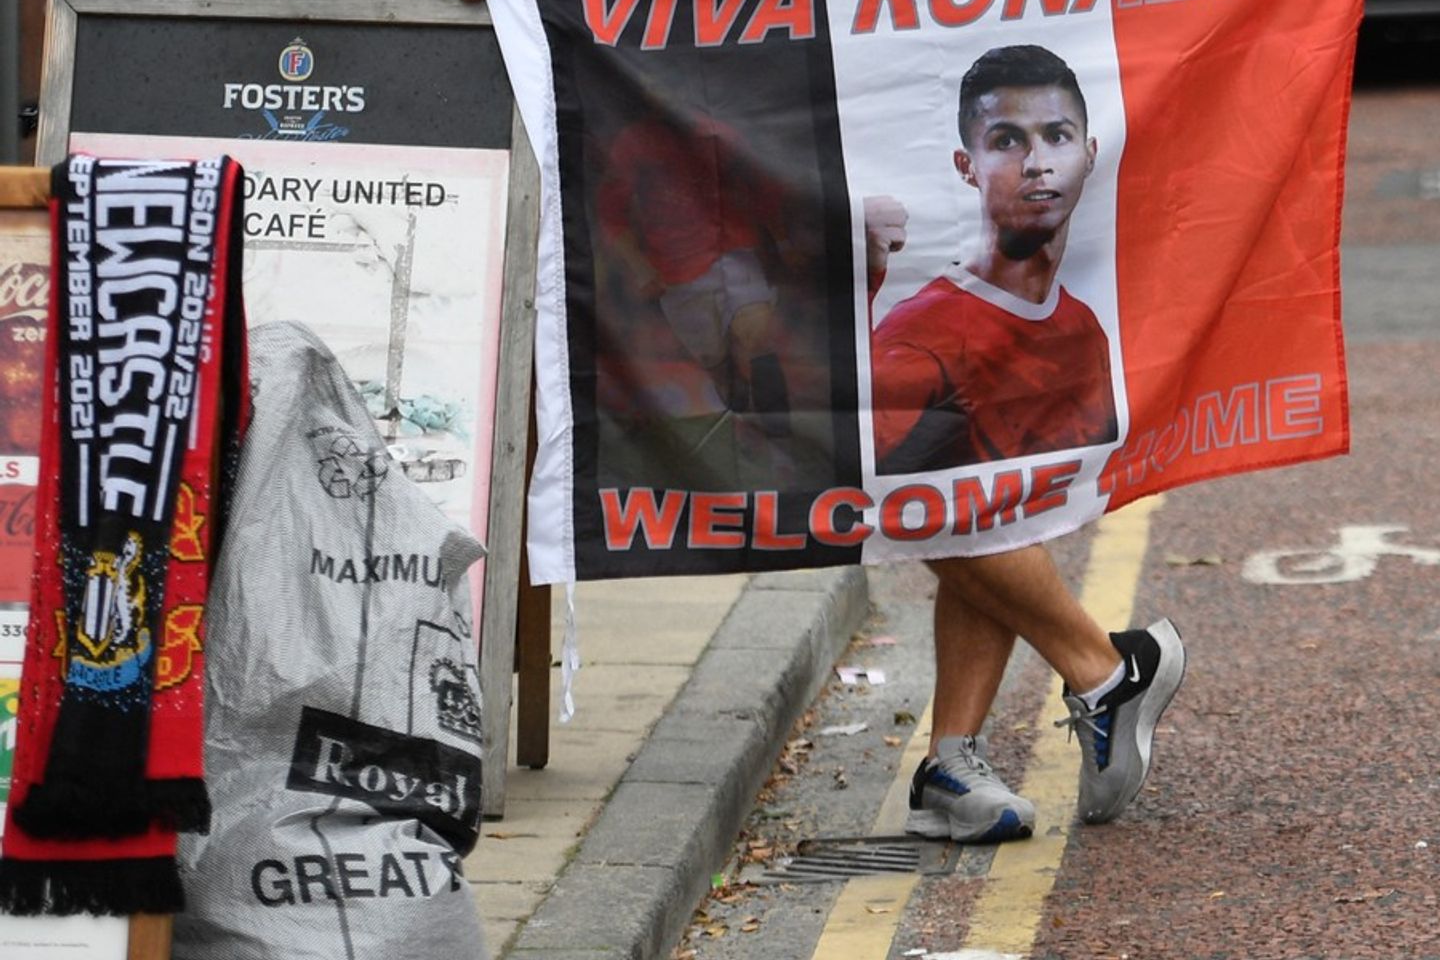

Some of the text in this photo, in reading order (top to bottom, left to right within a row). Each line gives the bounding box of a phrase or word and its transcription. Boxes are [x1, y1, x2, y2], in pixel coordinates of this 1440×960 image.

[222, 83, 366, 113] FOSTER'S
[332, 179, 446, 208] UNITED
[243, 208, 327, 239] CAFÉ
[95, 159, 189, 518] NEWCASTLE
[164, 271, 208, 420] 2021/22
[70, 354, 95, 440] 2021
[598, 460, 1082, 551] WELCOME
[310, 547, 447, 593] MAXIMU
[2, 625, 28, 637] 33
[310, 735, 467, 820] Royal
[251, 851, 435, 909] GREAT
